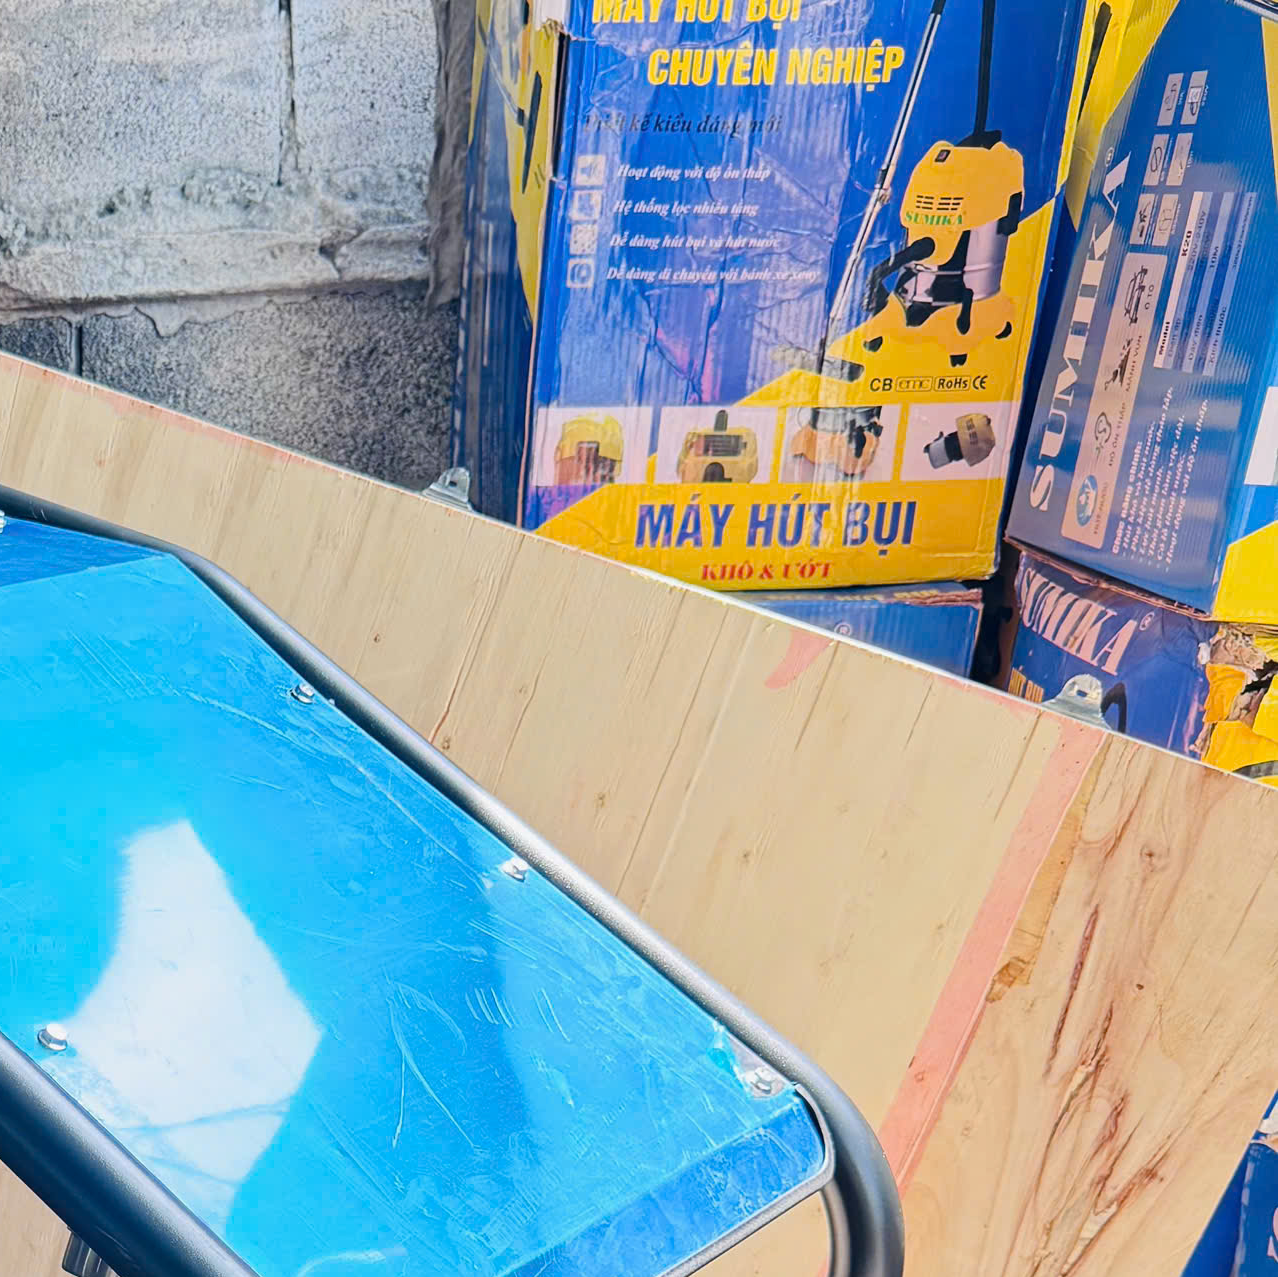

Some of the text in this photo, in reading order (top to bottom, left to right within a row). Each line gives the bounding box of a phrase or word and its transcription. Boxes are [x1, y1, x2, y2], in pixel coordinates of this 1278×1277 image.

[647, 39, 905, 91] CHUYÊN NGHIỆP
[1181, 230, 1192, 256] K20
[1030, 152, 1131, 512] SUMIKA
[870, 378, 893, 392] CB
[937, 378, 968, 390] RoHs
[634, 493, 917, 556] MÁY HÚT BỤI
[701, 563, 753, 581] KHÔ
[1021, 567, 1138, 676] SUMIKA
